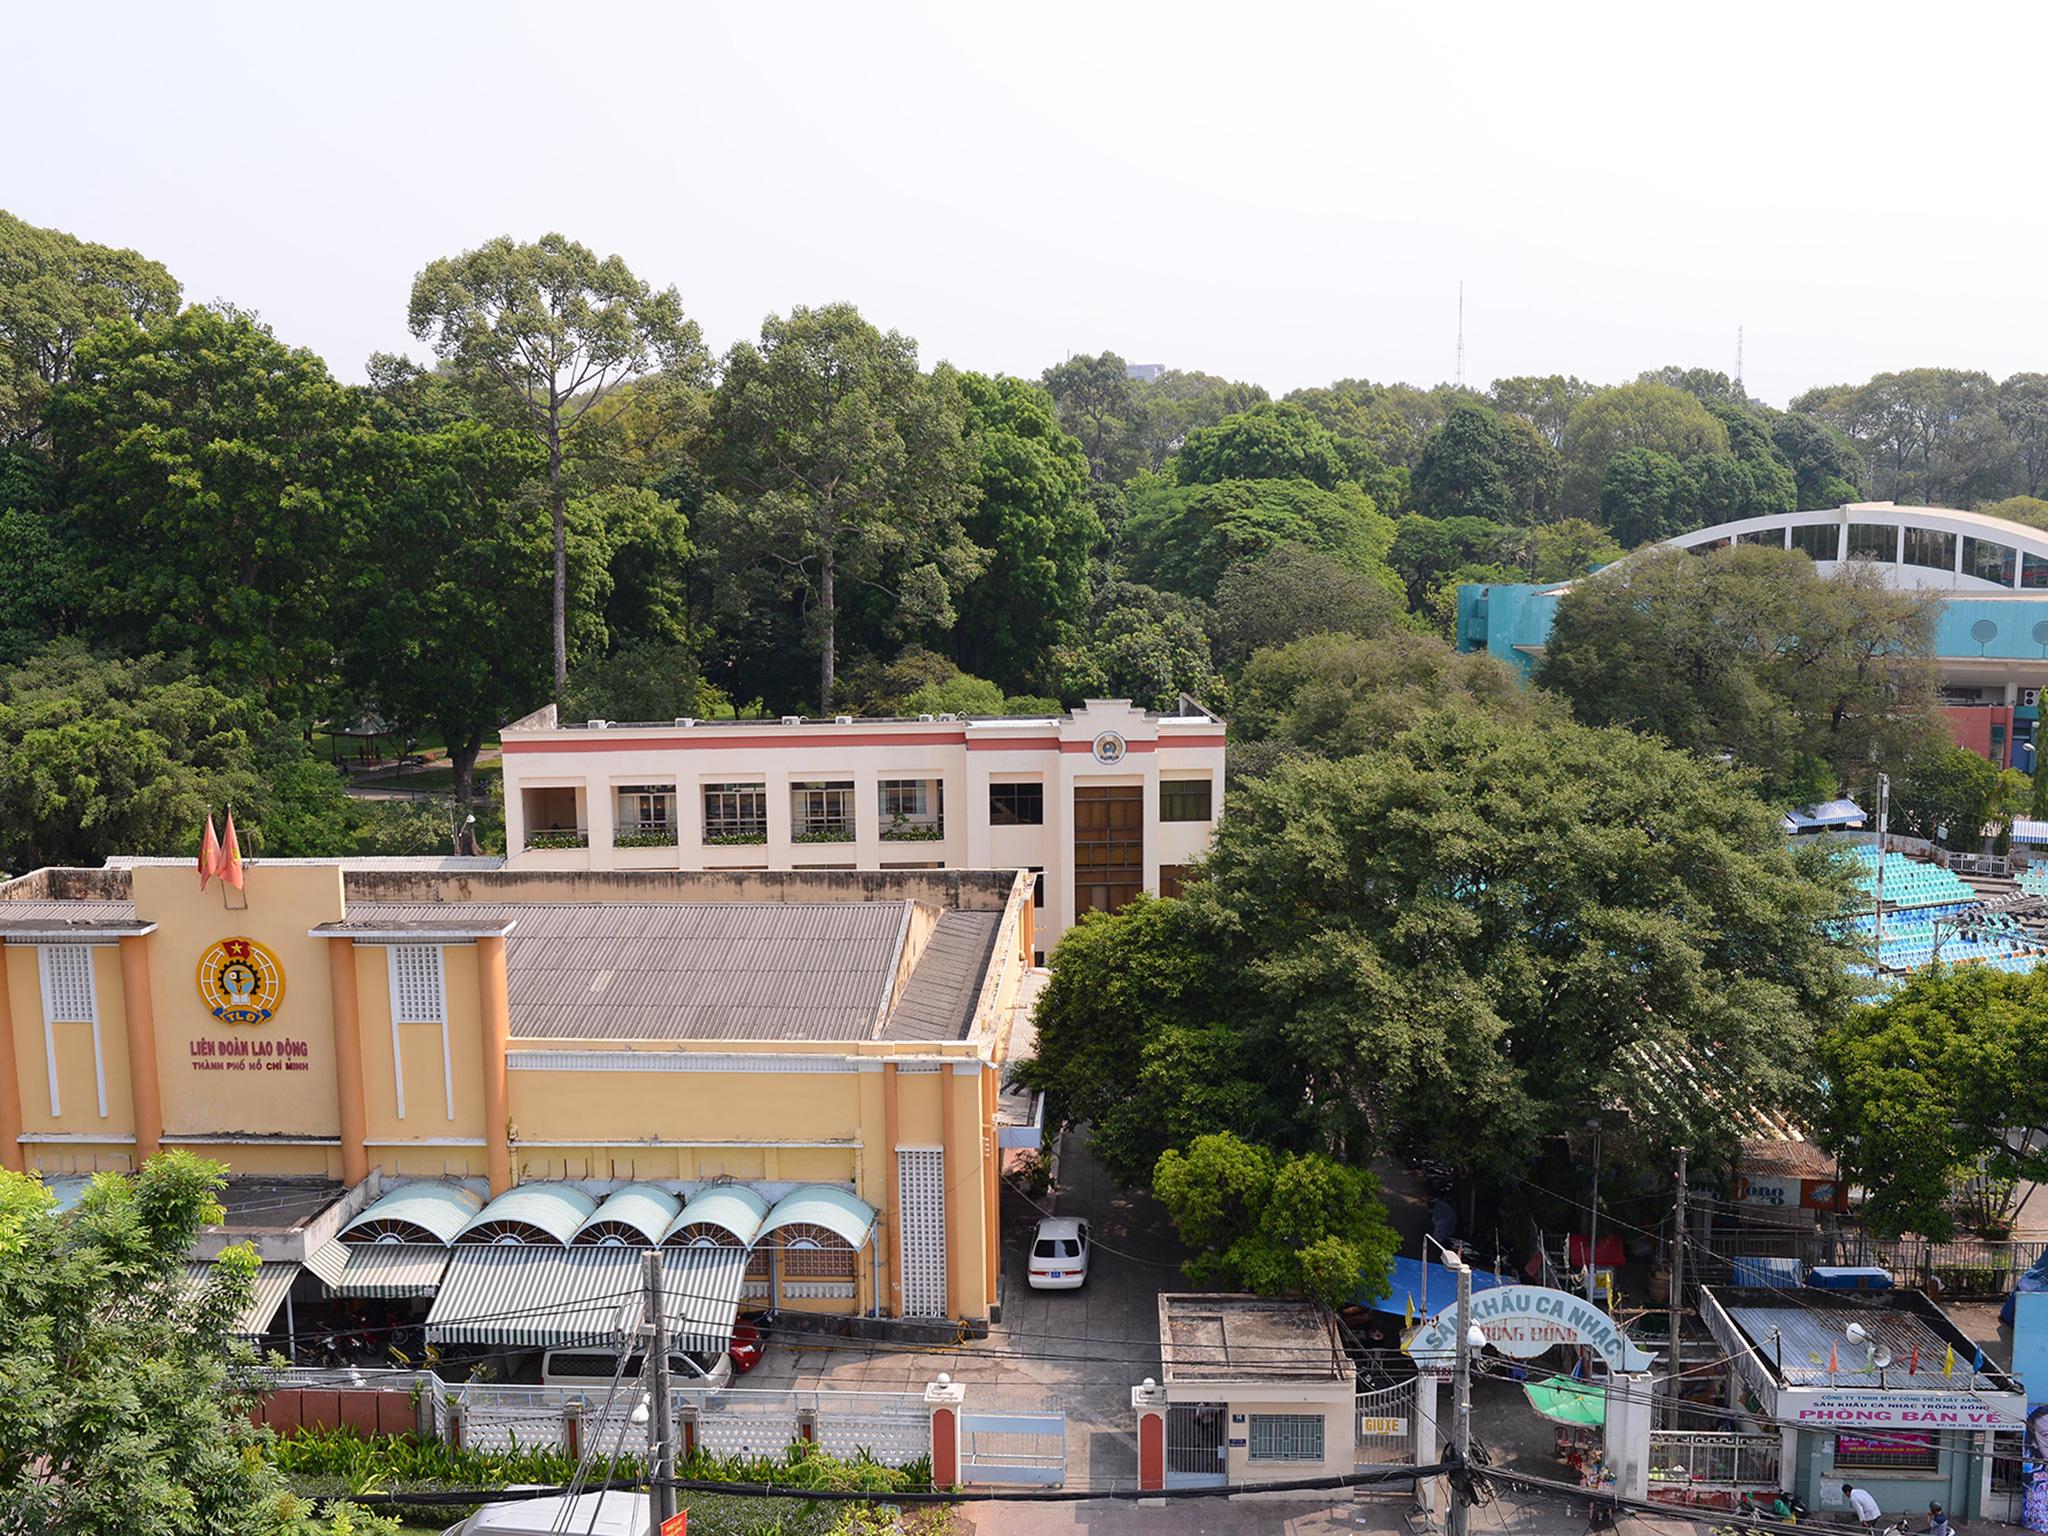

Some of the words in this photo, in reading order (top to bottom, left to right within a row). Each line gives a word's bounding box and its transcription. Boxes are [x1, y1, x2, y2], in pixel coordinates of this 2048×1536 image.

[190, 1037, 216, 1056] LIÊN
[218, 1037, 249, 1056] ĐOÀN
[251, 1040, 273, 1056] LAO
[276, 1038, 308, 1061] ĐỘNG
[192, 1059, 224, 1070] THÀNH
[226, 1058, 246, 1070] PHỐ
[265, 1059, 282, 1070] CHÍ
[285, 1061, 309, 1070] MINH
[1535, 1296, 1564, 1319] CA
[1567, 1306, 1623, 1355] NHẠC
[1799, 1408, 1891, 1421] PHÒNG
[1902, 1410, 1958, 1422] BÁN
[1968, 1410, 2001, 1423] VÉ
